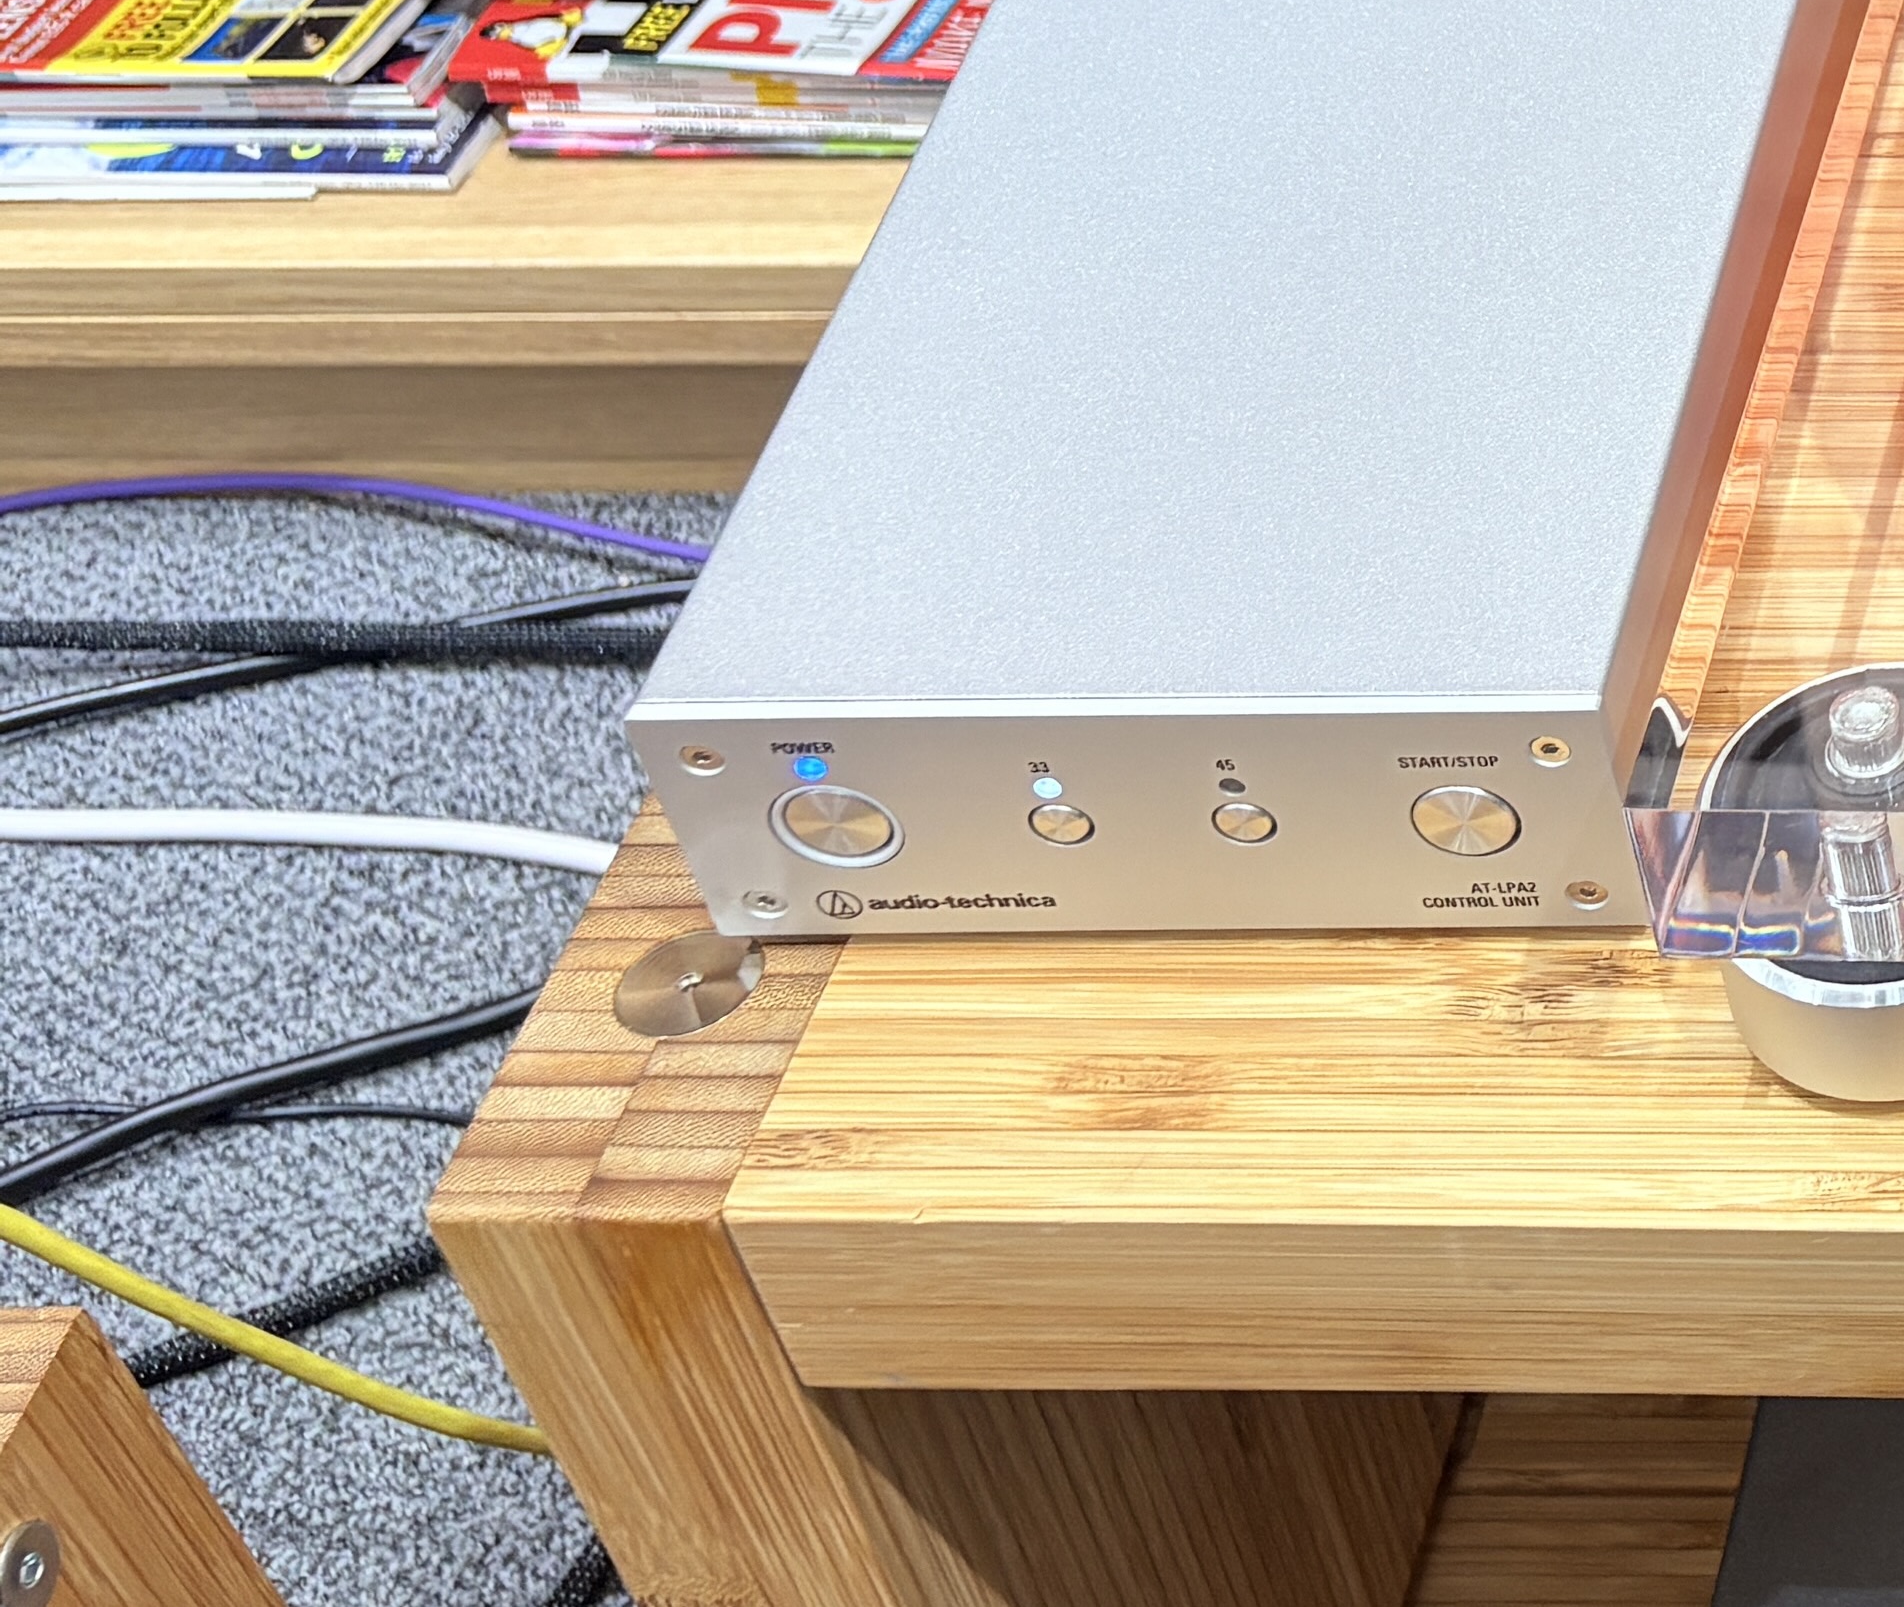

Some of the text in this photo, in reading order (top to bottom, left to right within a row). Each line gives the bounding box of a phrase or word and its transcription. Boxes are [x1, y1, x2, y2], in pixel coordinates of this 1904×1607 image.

[771, 741, 835, 755] POWER
[1028, 761, 1050, 774] 33
[1215, 759, 1236, 772] 45
[1397, 755, 1499, 770] START/STOP
[1471, 882, 1537, 894] AT-LPA2
[868, 892, 1056, 911] audio-technica
[1422, 895, 1541, 909] CONTROL UNIT
